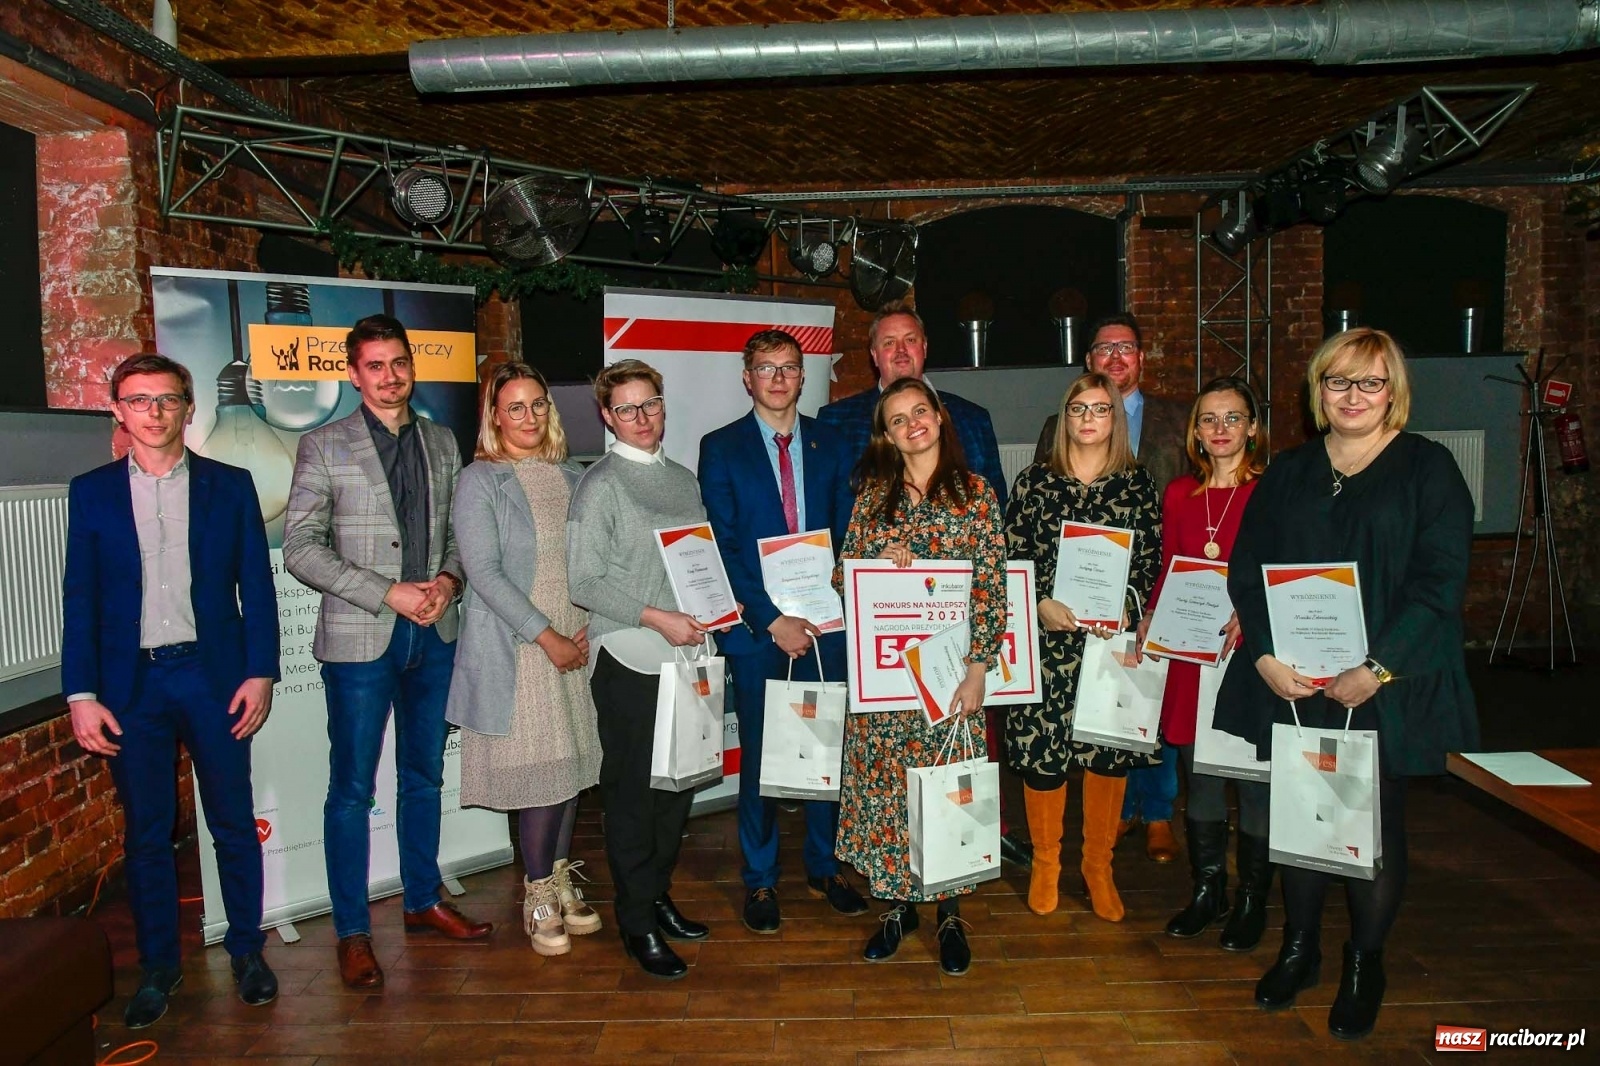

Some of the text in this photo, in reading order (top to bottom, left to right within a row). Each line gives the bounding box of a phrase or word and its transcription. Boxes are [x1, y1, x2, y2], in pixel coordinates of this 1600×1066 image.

[306, 336, 453, 360] Przeorczy
[925, 601, 968, 609] NAJLEPSZY
[927, 611, 966, 621] 2021
[874, 624, 911, 632] NAGRODA
